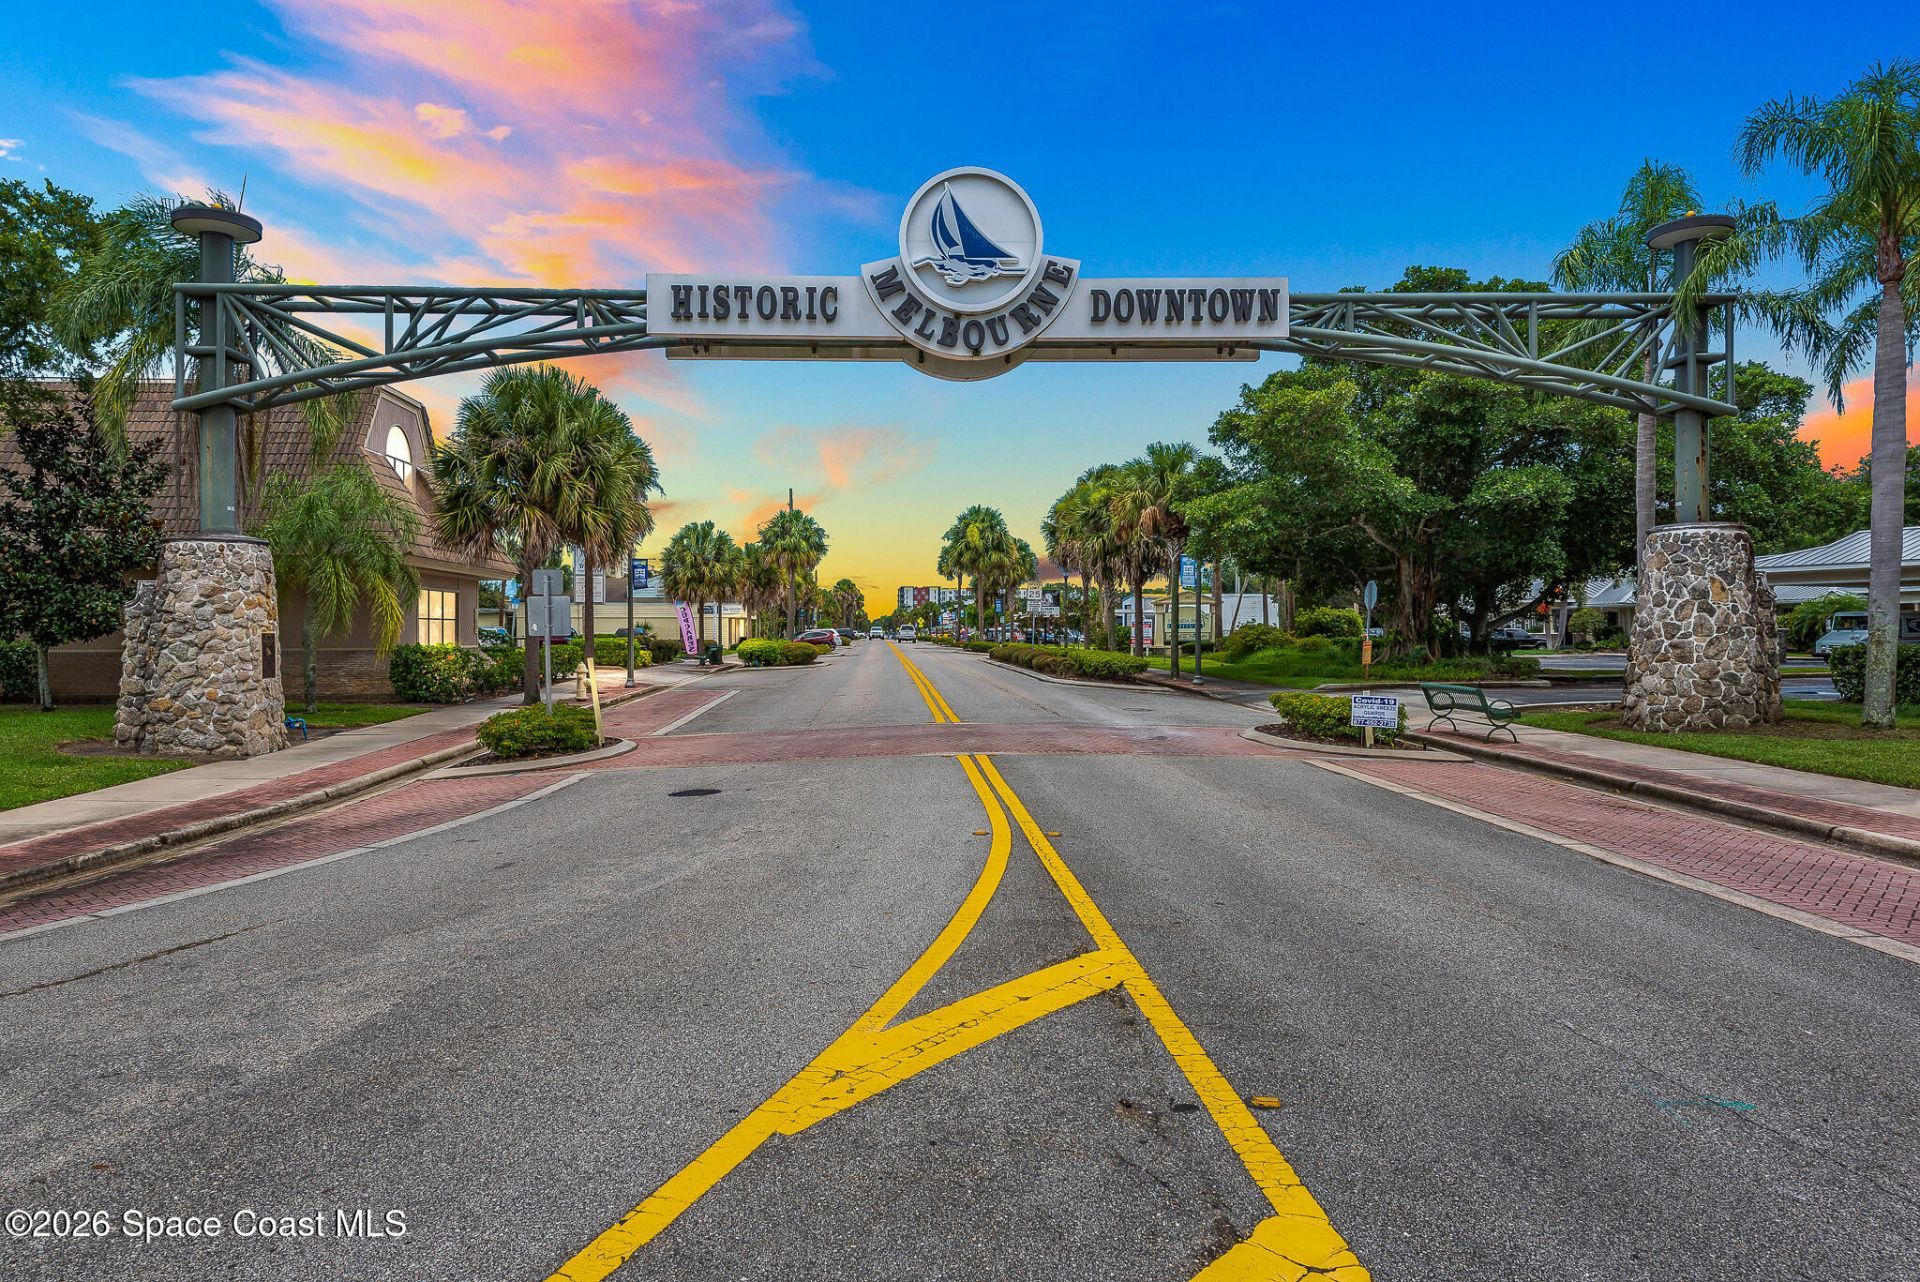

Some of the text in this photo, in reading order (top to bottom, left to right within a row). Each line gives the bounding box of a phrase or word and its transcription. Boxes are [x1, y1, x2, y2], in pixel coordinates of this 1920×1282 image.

[671, 285, 838, 321] HISTORIC
[869, 259, 1074, 350] MELBOURNE
[1090, 288, 1280, 322] DOWNTOWN
[1029, 590, 1041, 598] 25
